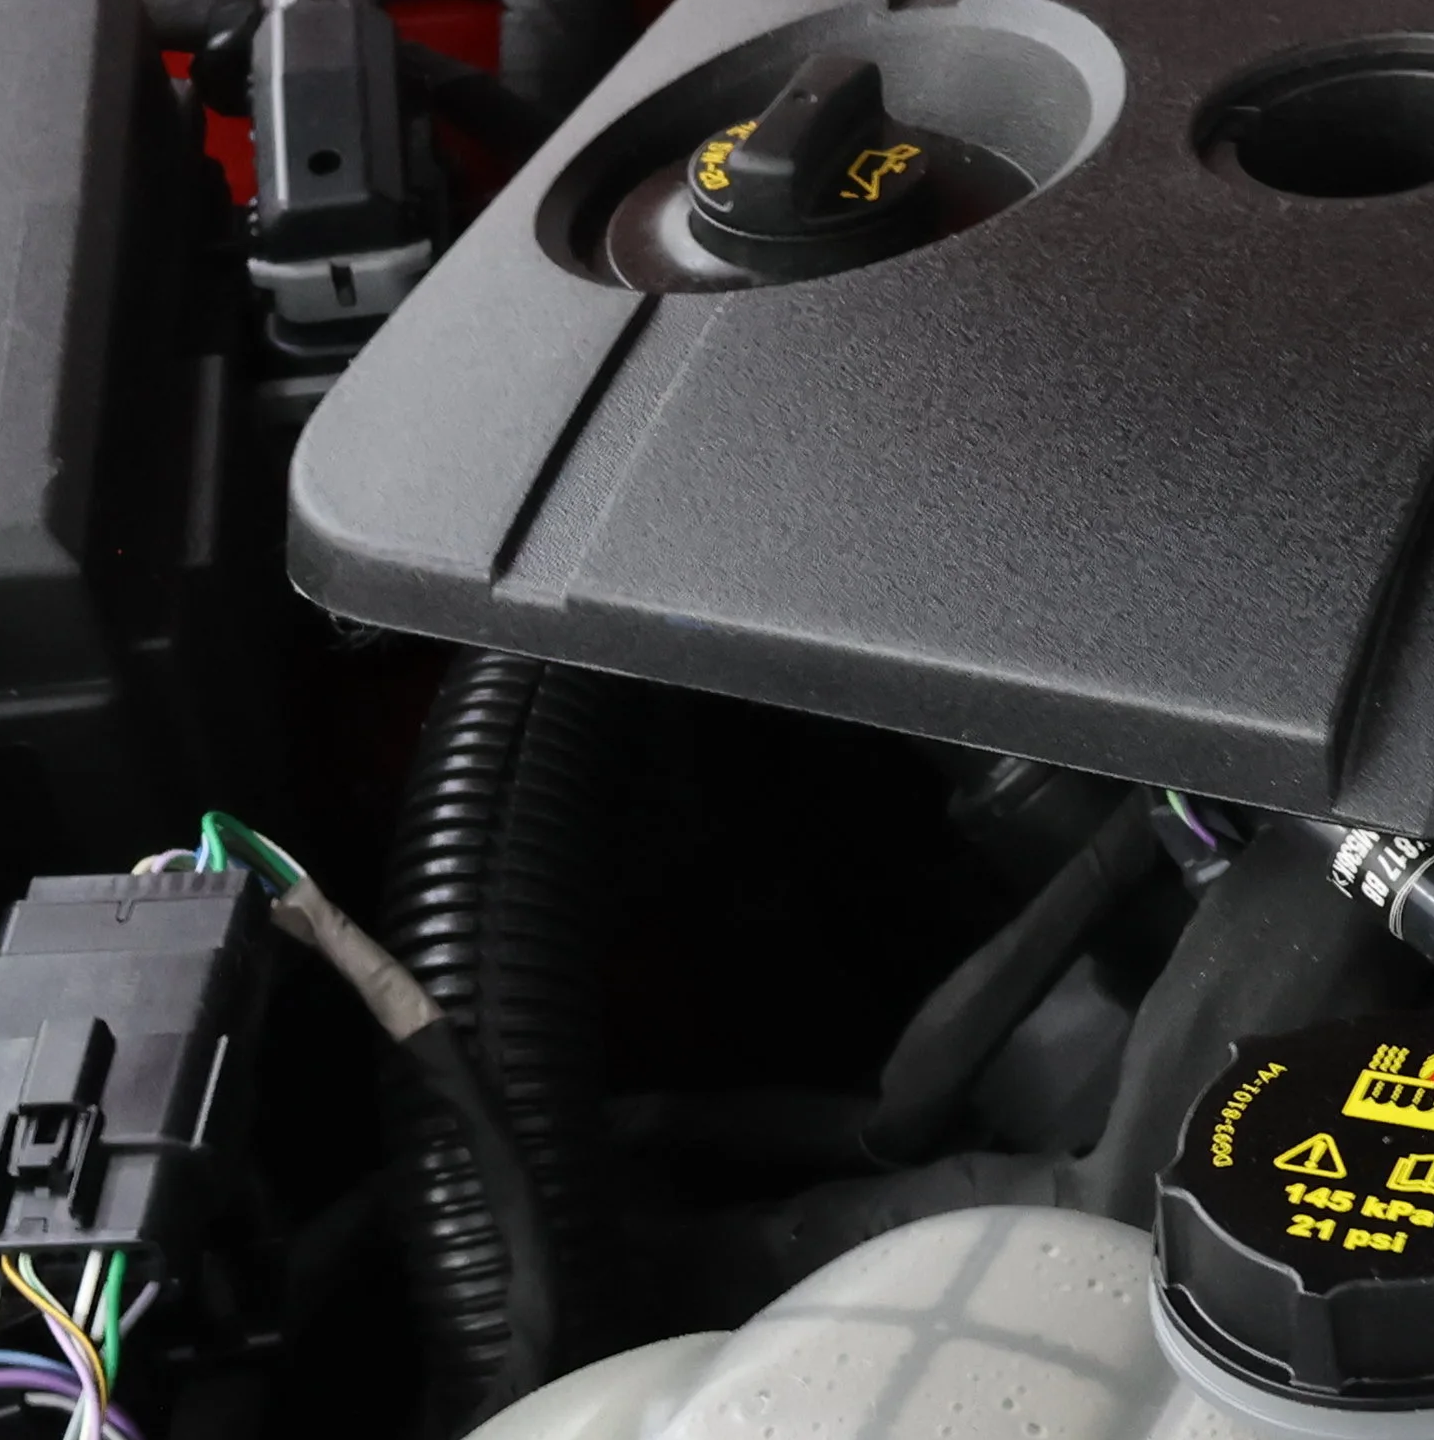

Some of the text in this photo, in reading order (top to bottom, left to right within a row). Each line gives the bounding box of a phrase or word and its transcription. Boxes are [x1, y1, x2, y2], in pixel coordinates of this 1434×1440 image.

[1284, 1180, 1356, 1214] 145
[1286, 1214, 1408, 1254] 21 psi
